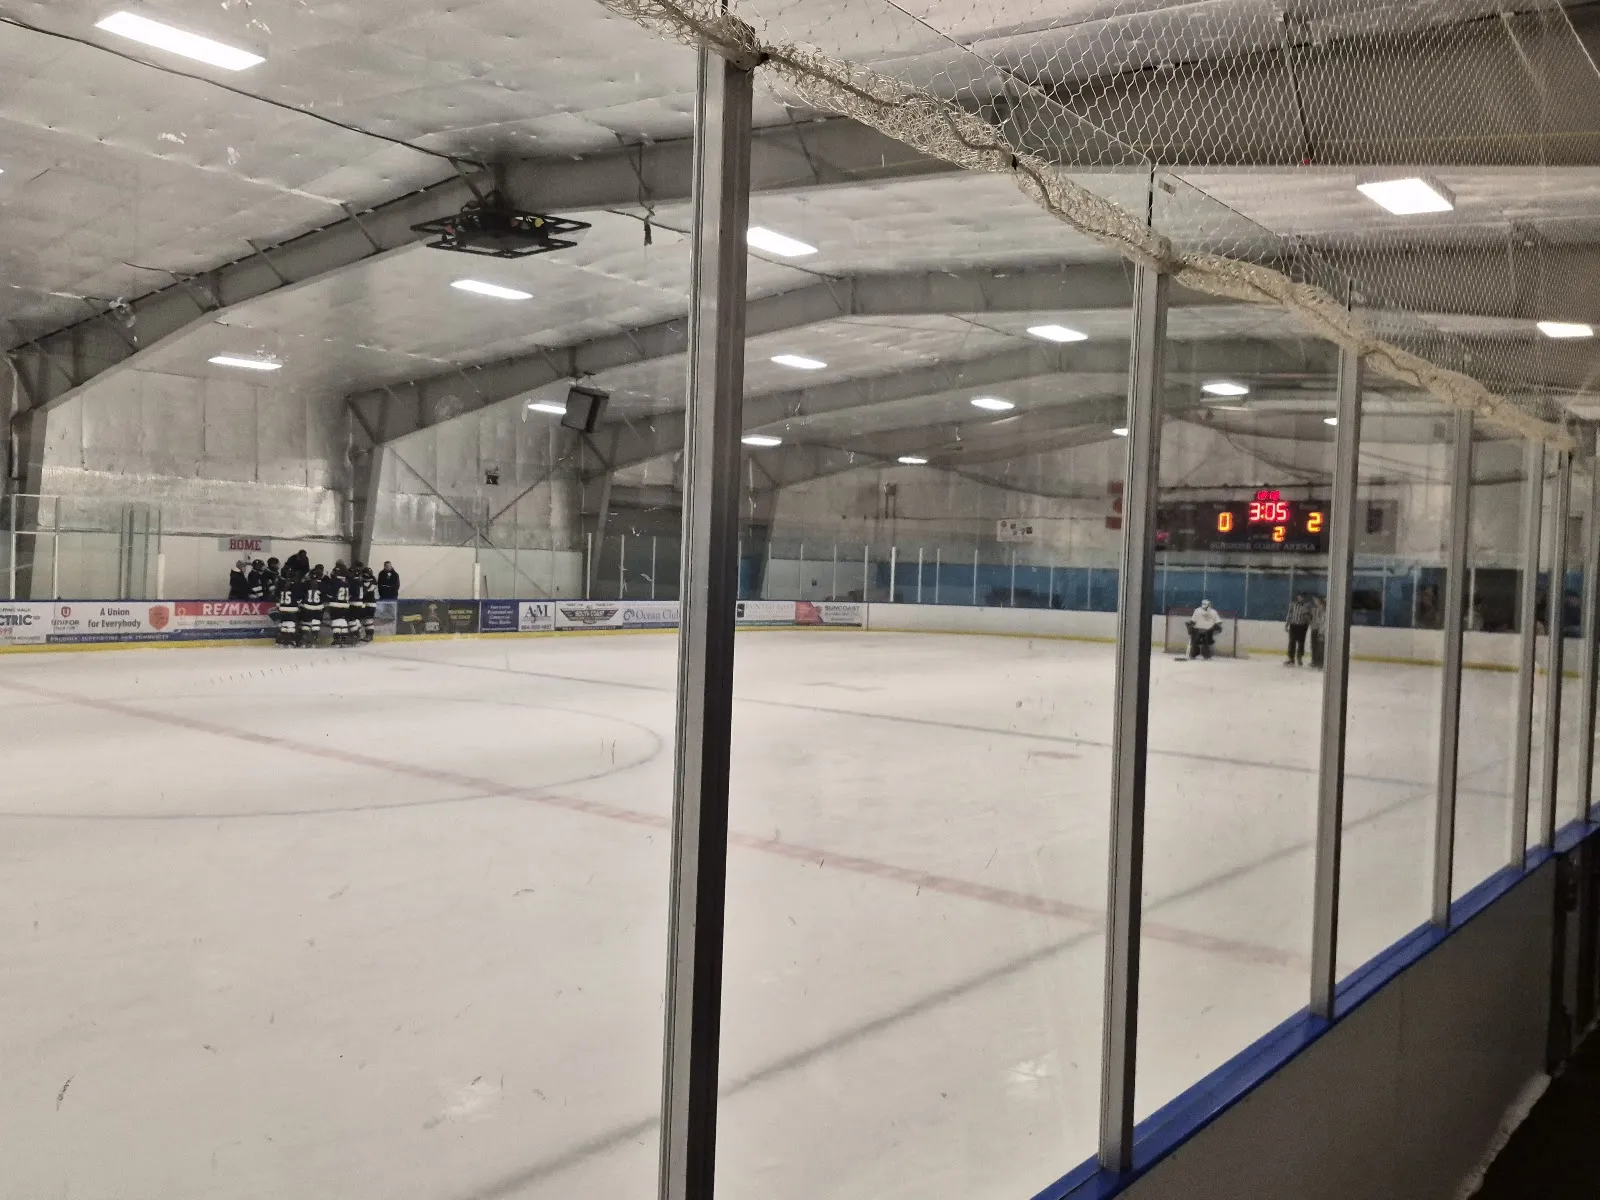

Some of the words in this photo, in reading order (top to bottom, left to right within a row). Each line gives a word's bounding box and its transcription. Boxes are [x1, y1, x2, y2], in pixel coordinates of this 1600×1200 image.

[1249, 502, 1288, 521] 3:05
[1217, 511, 1233, 532] 0
[1306, 511, 1324, 533] 2
[1271, 525, 1286, 542] 2
[229, 538, 262, 551] HOME
[280, 590, 292, 604] 15
[307, 589, 321, 603] 16
[100, 608, 105, 616] A
[107, 608, 130, 616] Union
[202, 602, 260, 615] RE/MAX
[635, 608, 660, 620] Ocean
[88, 619, 99, 628] for
[101, 619, 141, 629] Everybody
